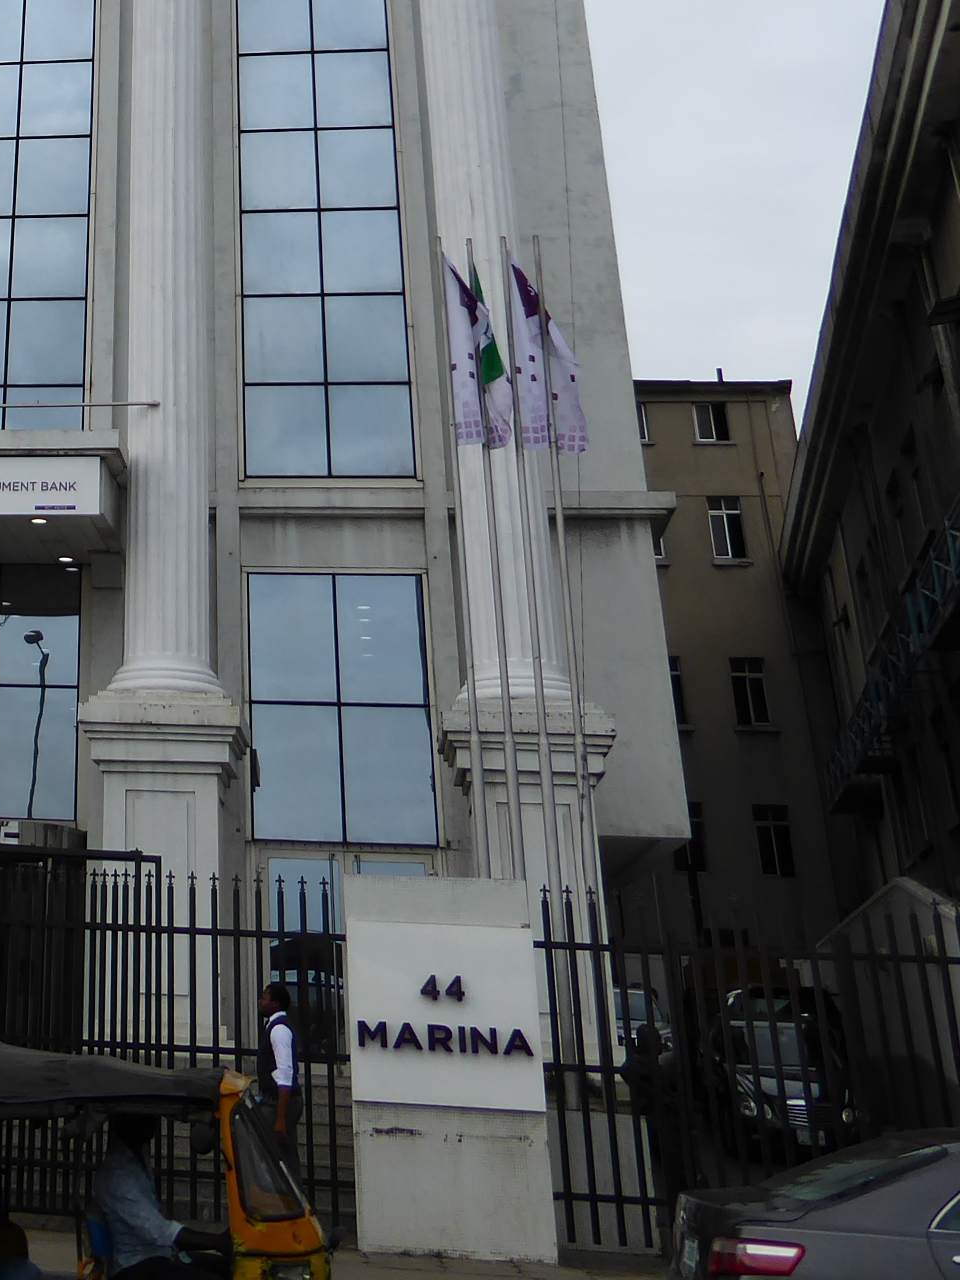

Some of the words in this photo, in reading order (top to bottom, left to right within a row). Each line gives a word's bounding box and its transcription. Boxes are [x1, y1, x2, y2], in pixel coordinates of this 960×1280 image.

[40, 481, 76, 491] BANK
[420, 974, 465, 1001] 44
[357, 1020, 534, 1056] MARINA
